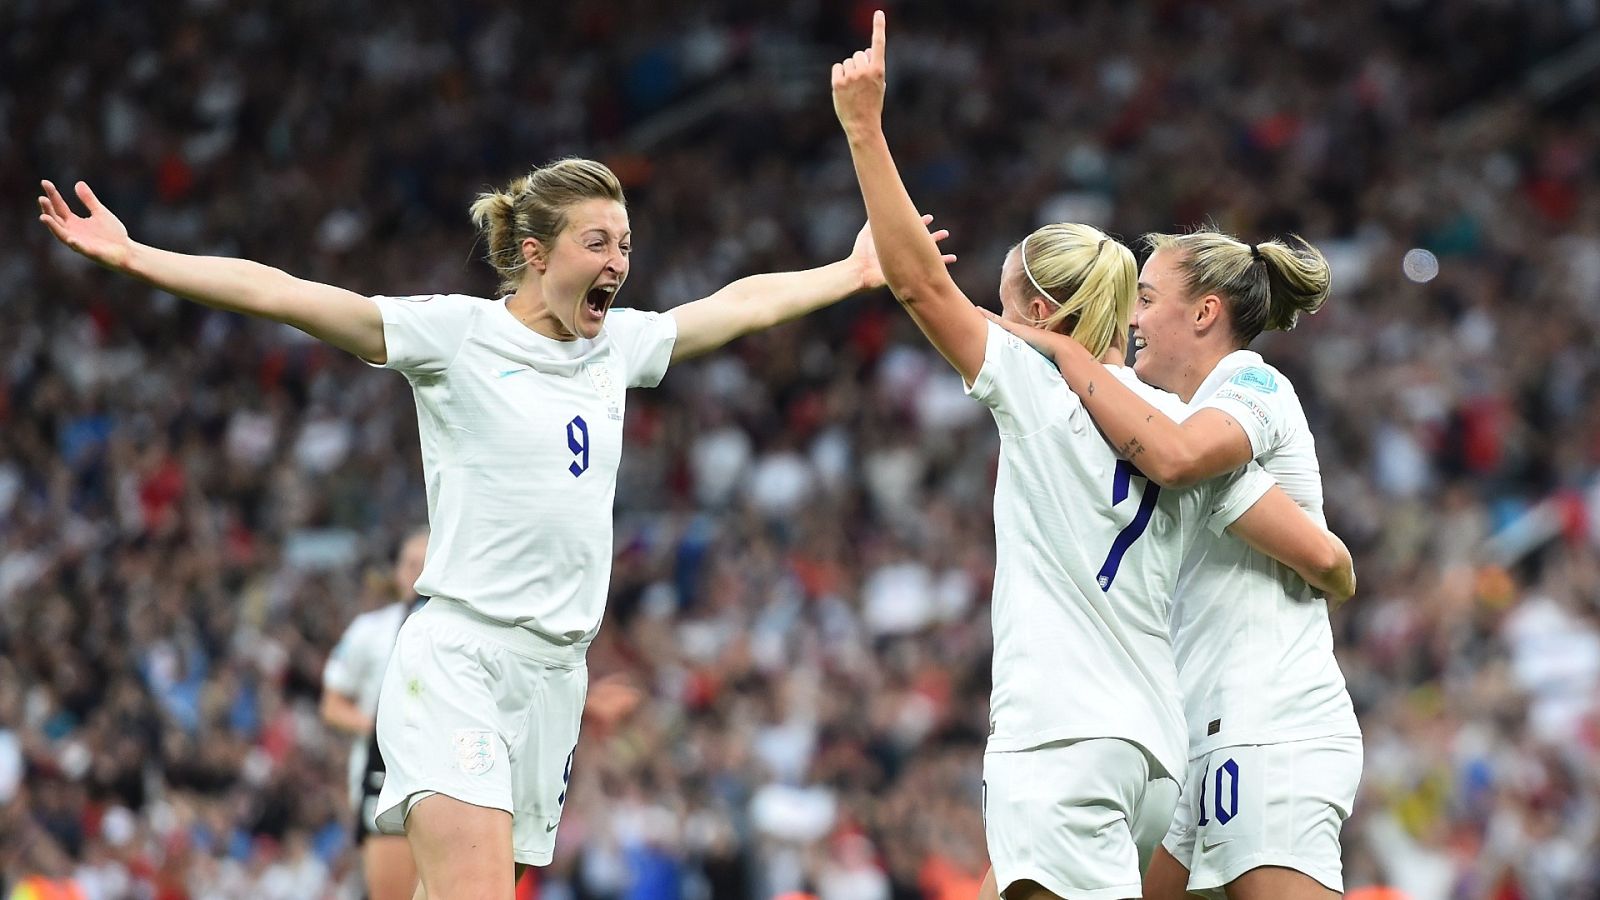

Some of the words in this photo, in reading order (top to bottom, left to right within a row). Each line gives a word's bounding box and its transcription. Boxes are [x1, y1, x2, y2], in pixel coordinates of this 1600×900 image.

[566, 415, 589, 478] 9
[1096, 458, 1161, 593] 7
[1198, 758, 1239, 826] 10
